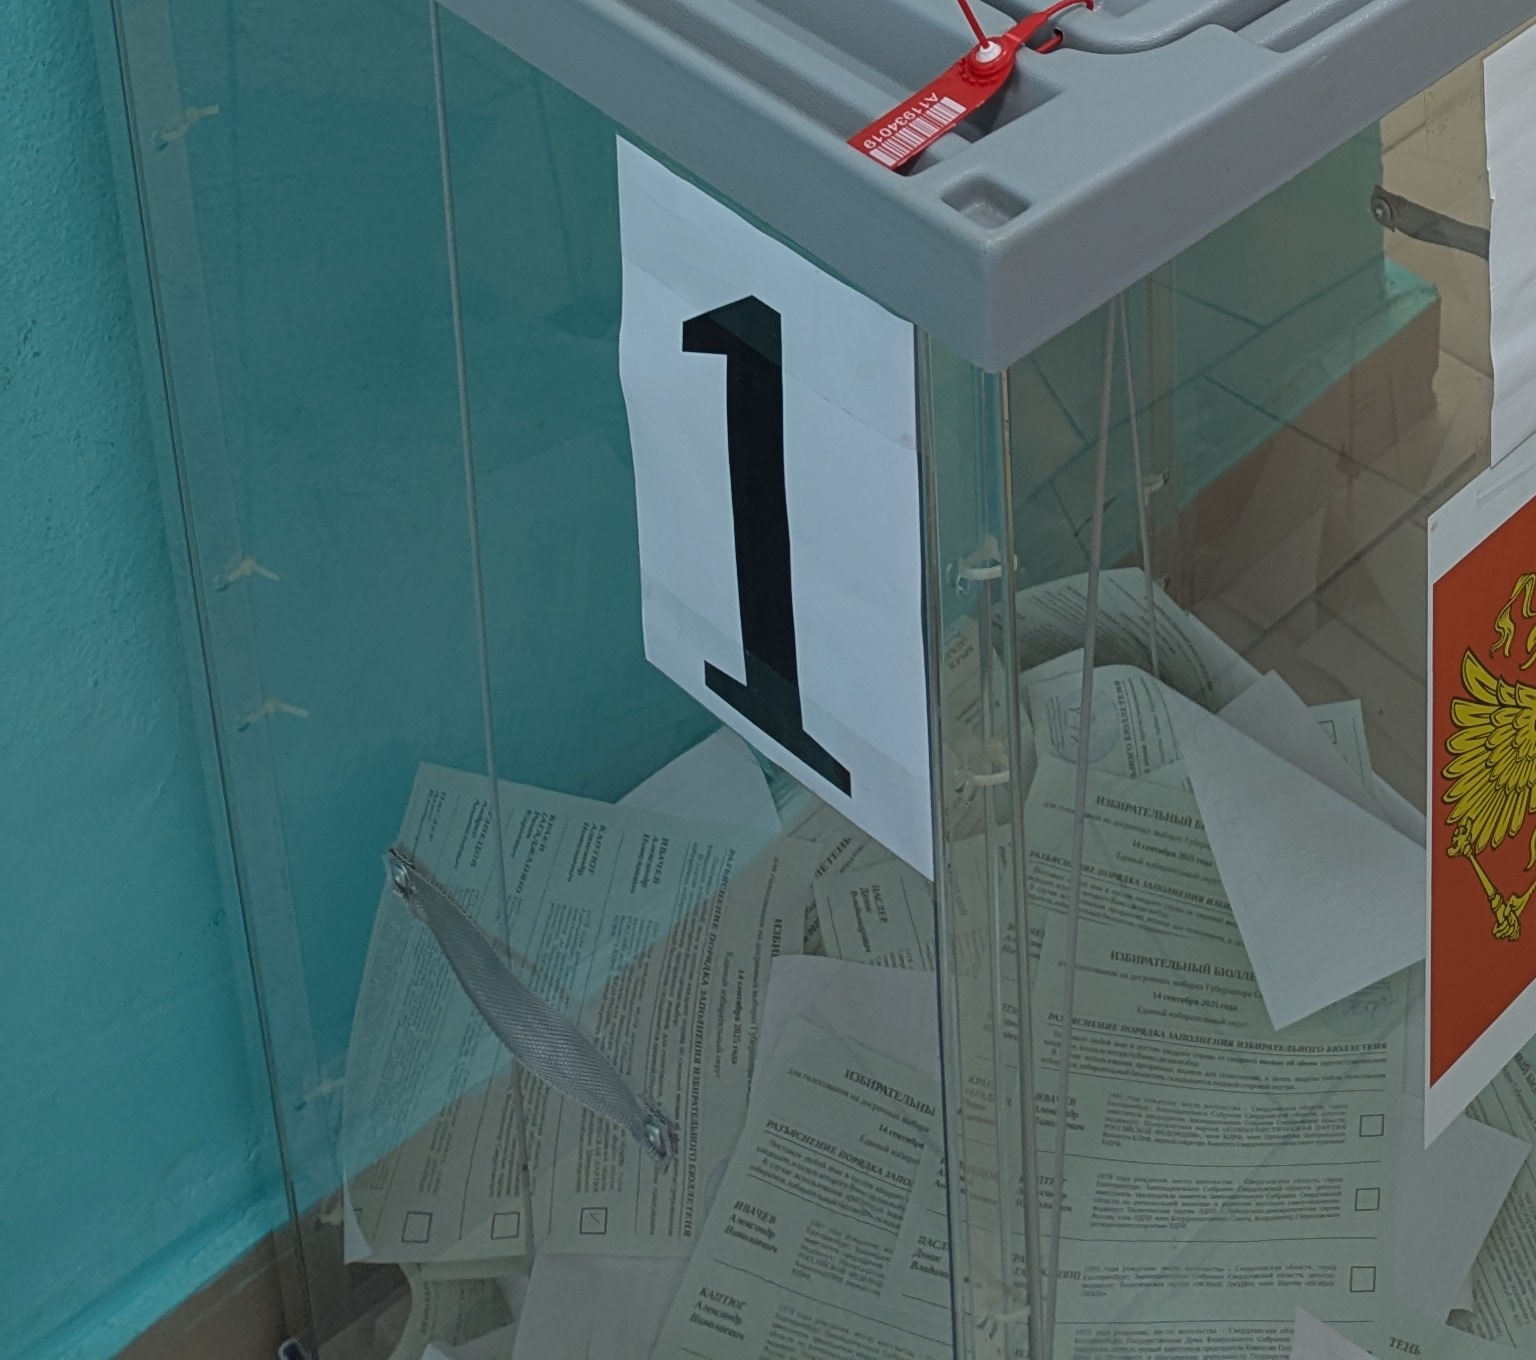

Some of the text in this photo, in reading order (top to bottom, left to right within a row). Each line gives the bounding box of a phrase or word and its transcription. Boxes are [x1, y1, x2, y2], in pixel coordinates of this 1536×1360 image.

[682, 295, 852, 797] 1
[1110, 950, 1212, 975] ИЗБИРАТЕЛЬНЫЙ
[1213, 965, 1256, 982] БЮЛЛЕ
[844, 1068, 936, 1116] ИЗБИРАТЕЛЬНЫ
[917, 1235, 947, 1250] ПАСЛ
